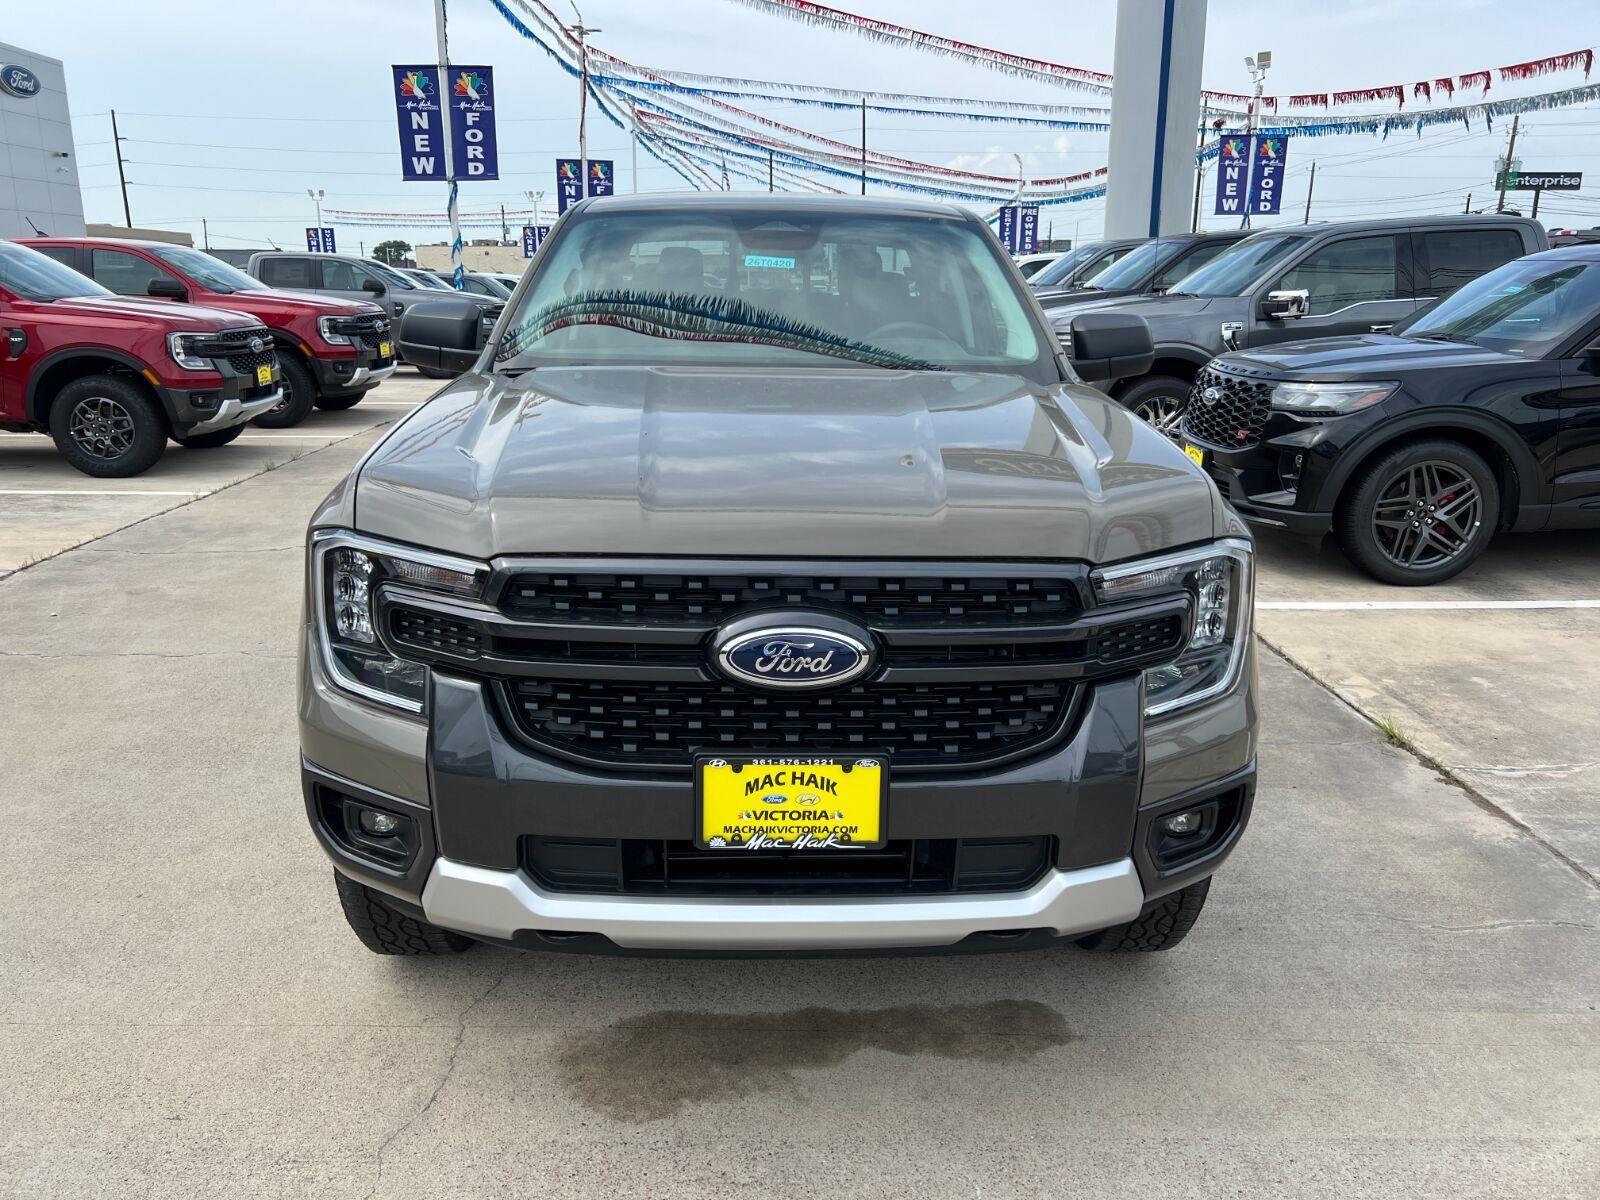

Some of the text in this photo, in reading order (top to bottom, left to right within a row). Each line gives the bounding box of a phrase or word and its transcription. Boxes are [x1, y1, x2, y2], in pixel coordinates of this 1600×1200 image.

[11, 70, 34, 91] Ford
[410, 112, 435, 175] NEW
[464, 112, 485, 175] FORD
[1222, 167, 1239, 211] NEW
[1259, 167, 1274, 211] FORD
[1022, 208, 1038, 216] PRE
[1024, 216, 1034, 250] OWNED
[755, 640, 834, 673] Ford
[744, 771, 838, 797] MAC HAIK
[765, 795, 784, 804] Ford
[751, 810, 830, 821] VICTORIA
[723, 825, 858, 834] MACHAIKVICTORIA.COM
[744, 832, 842, 850] Mac Haik
